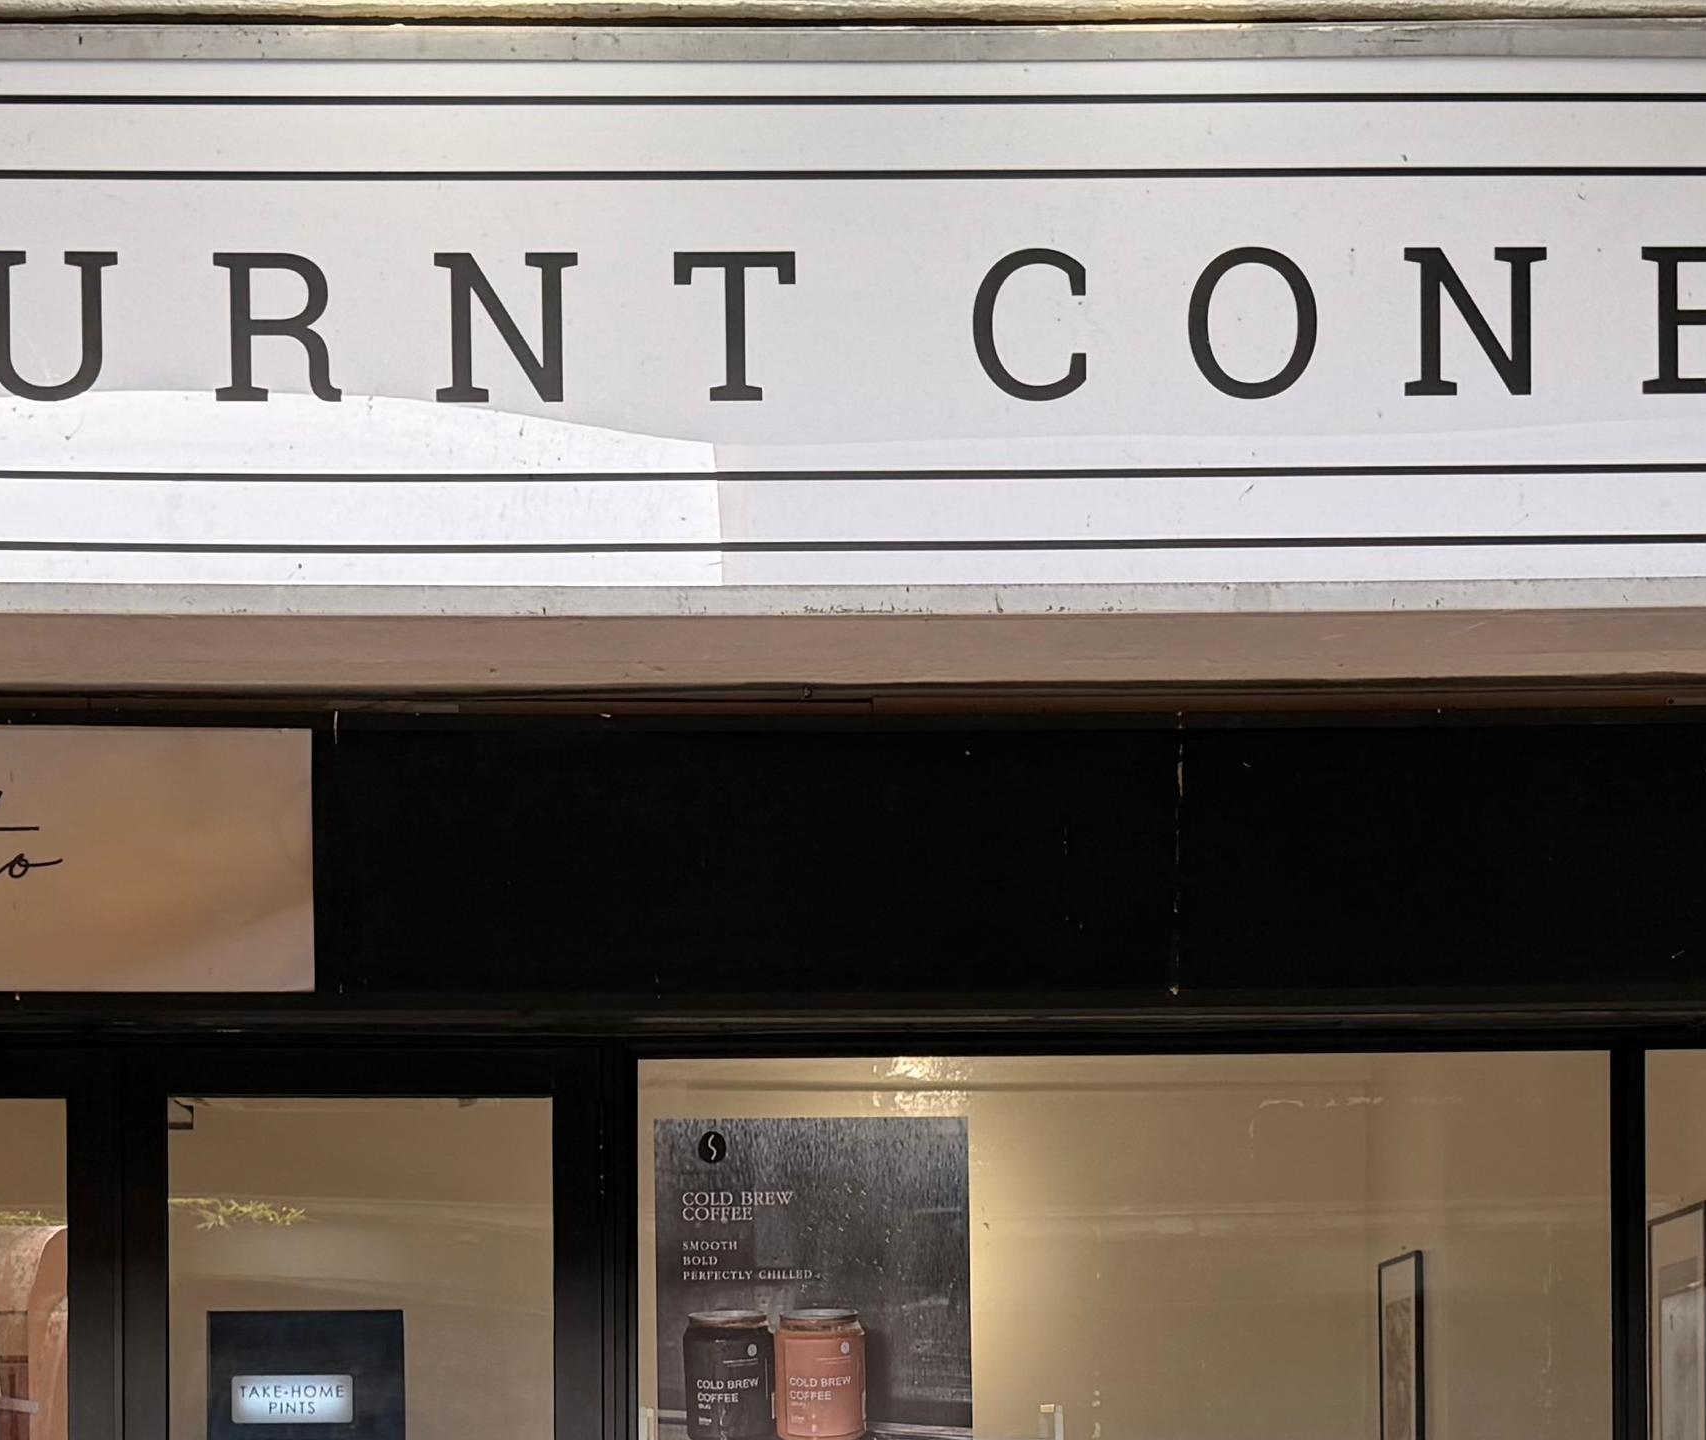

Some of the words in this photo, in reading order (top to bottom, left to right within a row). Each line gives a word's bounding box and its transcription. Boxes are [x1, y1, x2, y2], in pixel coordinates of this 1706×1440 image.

[682, 1191, 733, 1206] COLD
[741, 1191, 794, 1206] BREW
[682, 1206, 753, 1221] COFFEE
[682, 1240, 738, 1251] SMOOTH
[682, 1256, 718, 1266] BOLD
[682, 1270, 753, 1280] PERFECTLY
[758, 1270, 812, 1279] CHILLED
[696, 1379, 725, 1389] COLD
[727, 1377, 759, 1388] BREW
[789, 1377, 818, 1387] COLD
[821, 1376, 851, 1387] BREW
[239, 1384, 344, 1399] TAKE-HOME
[789, 1390, 832, 1401] COFFEE
[697, 1392, 739, 1403] COFFEE
[268, 1401, 316, 1415] PINTS
